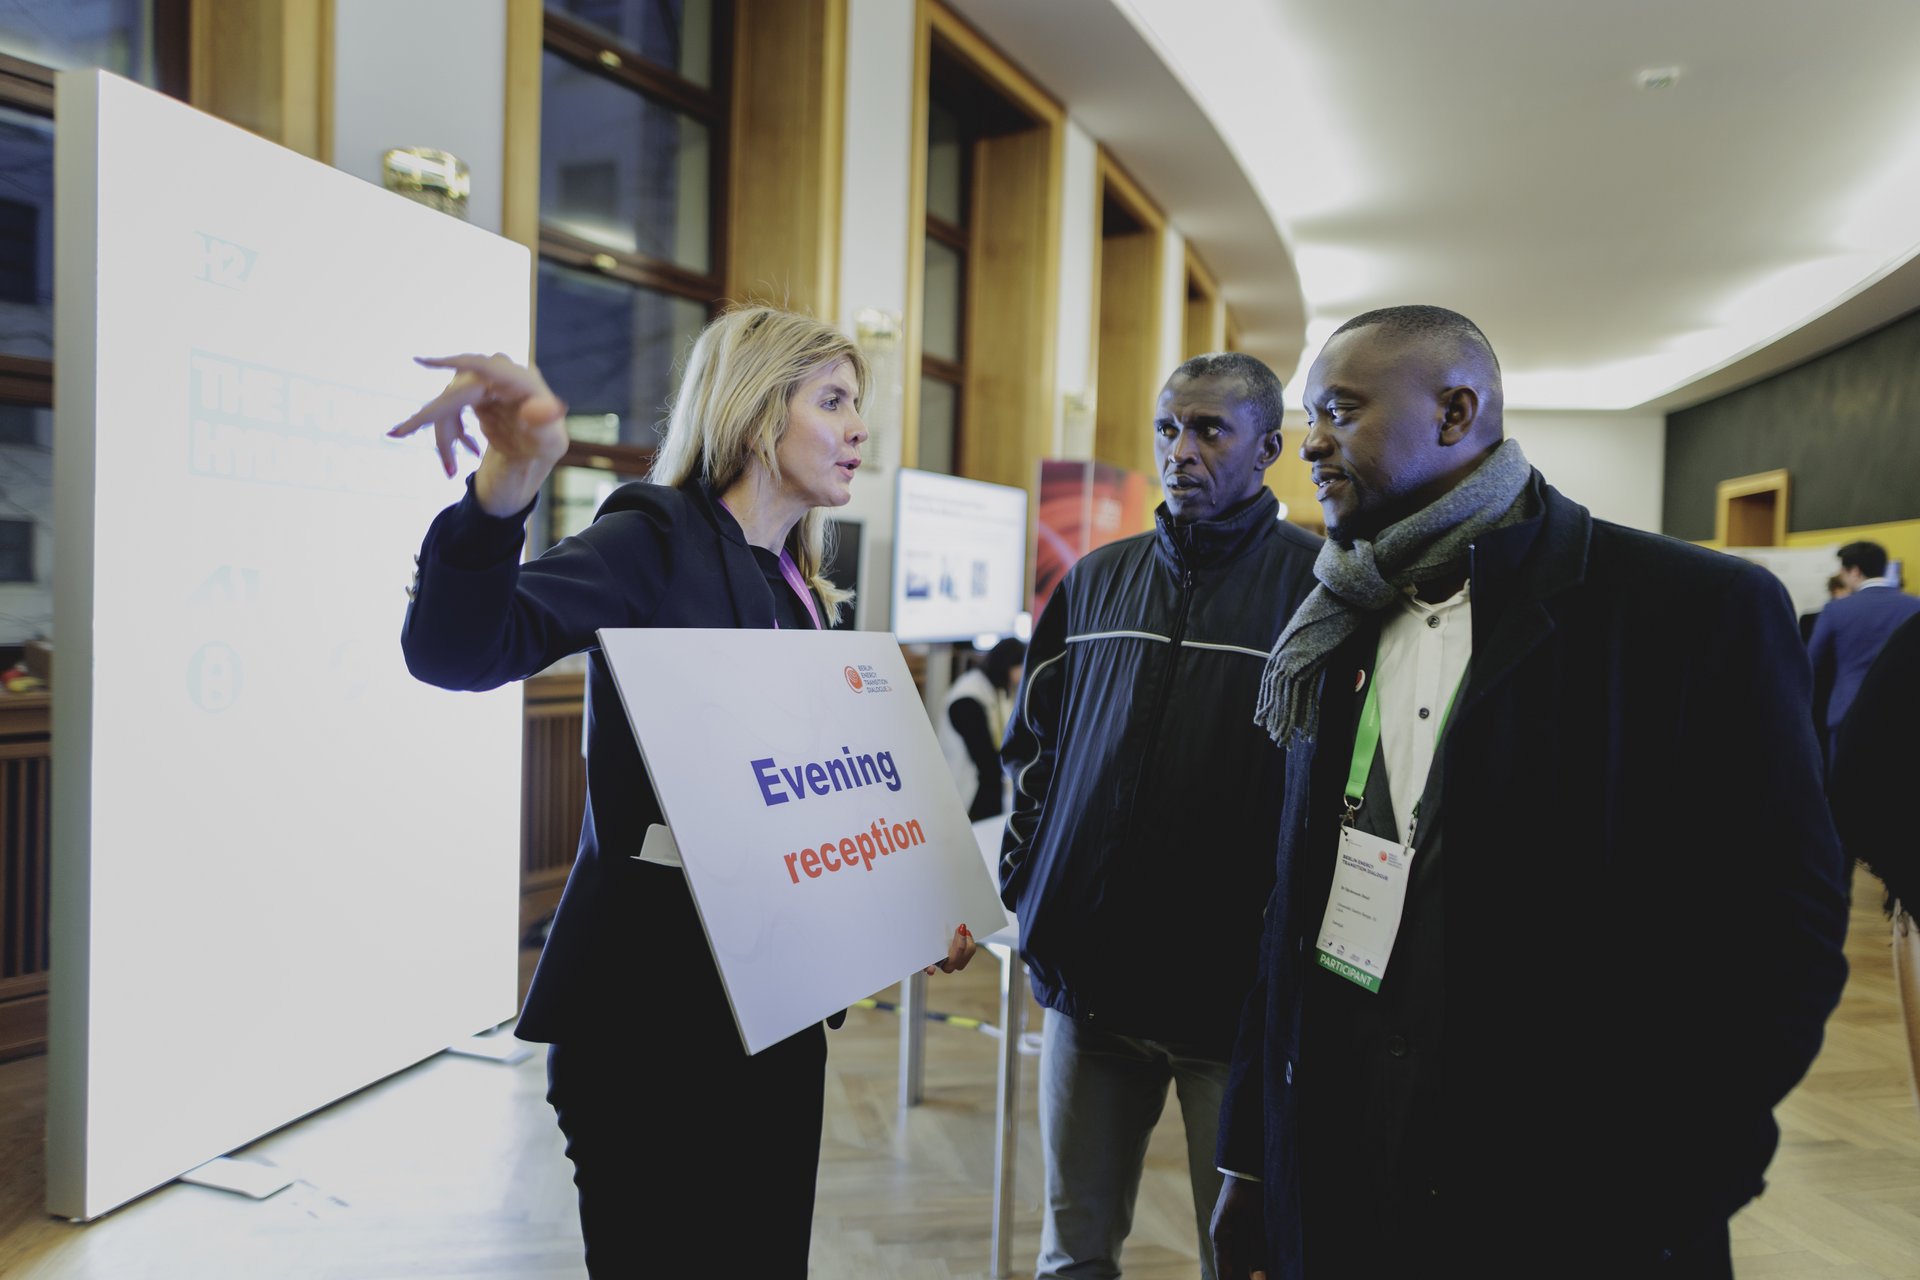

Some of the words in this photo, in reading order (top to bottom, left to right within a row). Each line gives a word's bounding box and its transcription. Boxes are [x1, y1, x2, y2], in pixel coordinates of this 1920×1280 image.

[750, 746, 902, 807] Evening
[784, 818, 926, 884] reception
[1320, 953, 1373, 986] PARTICIPANT
